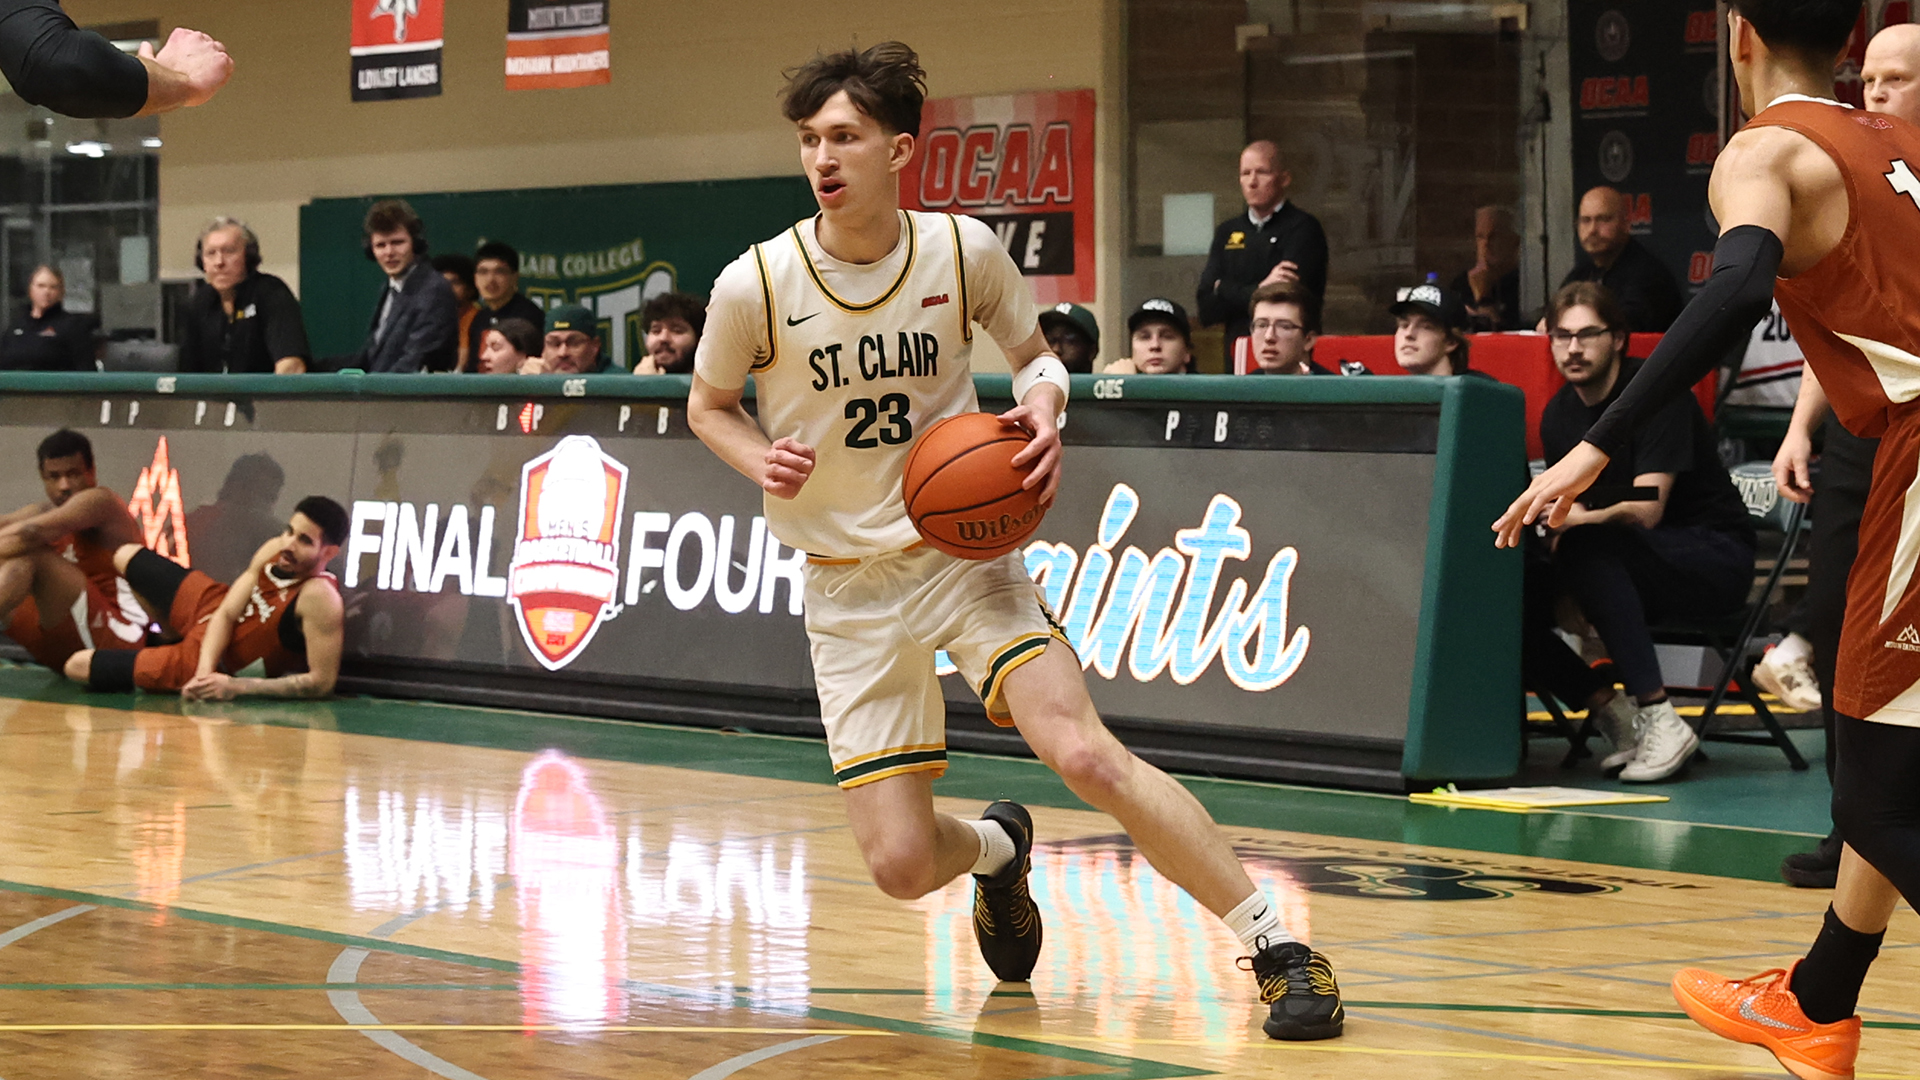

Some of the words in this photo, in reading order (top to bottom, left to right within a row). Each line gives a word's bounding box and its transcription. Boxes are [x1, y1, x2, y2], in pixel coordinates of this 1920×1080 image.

[1580, 76, 1649, 110] OCAA
[919, 121, 1074, 207] OCAA
[518, 252, 560, 279] LAIR
[562, 238, 644, 278] COLLEGE
[996, 220, 1047, 269] VE
[808, 343, 850, 392] ST.
[857, 331, 939, 381] CLAIR
[532, 403, 544, 431] P
[618, 405, 631, 432] P
[844, 392, 913, 449] 23
[1165, 410, 1181, 441] P
[1214, 411, 1229, 443] B
[955, 503, 1046, 541] Wilson
[344, 500, 507, 598] FINAL
[624, 511, 807, 615] FOUR
[934, 483, 1311, 693] aints
